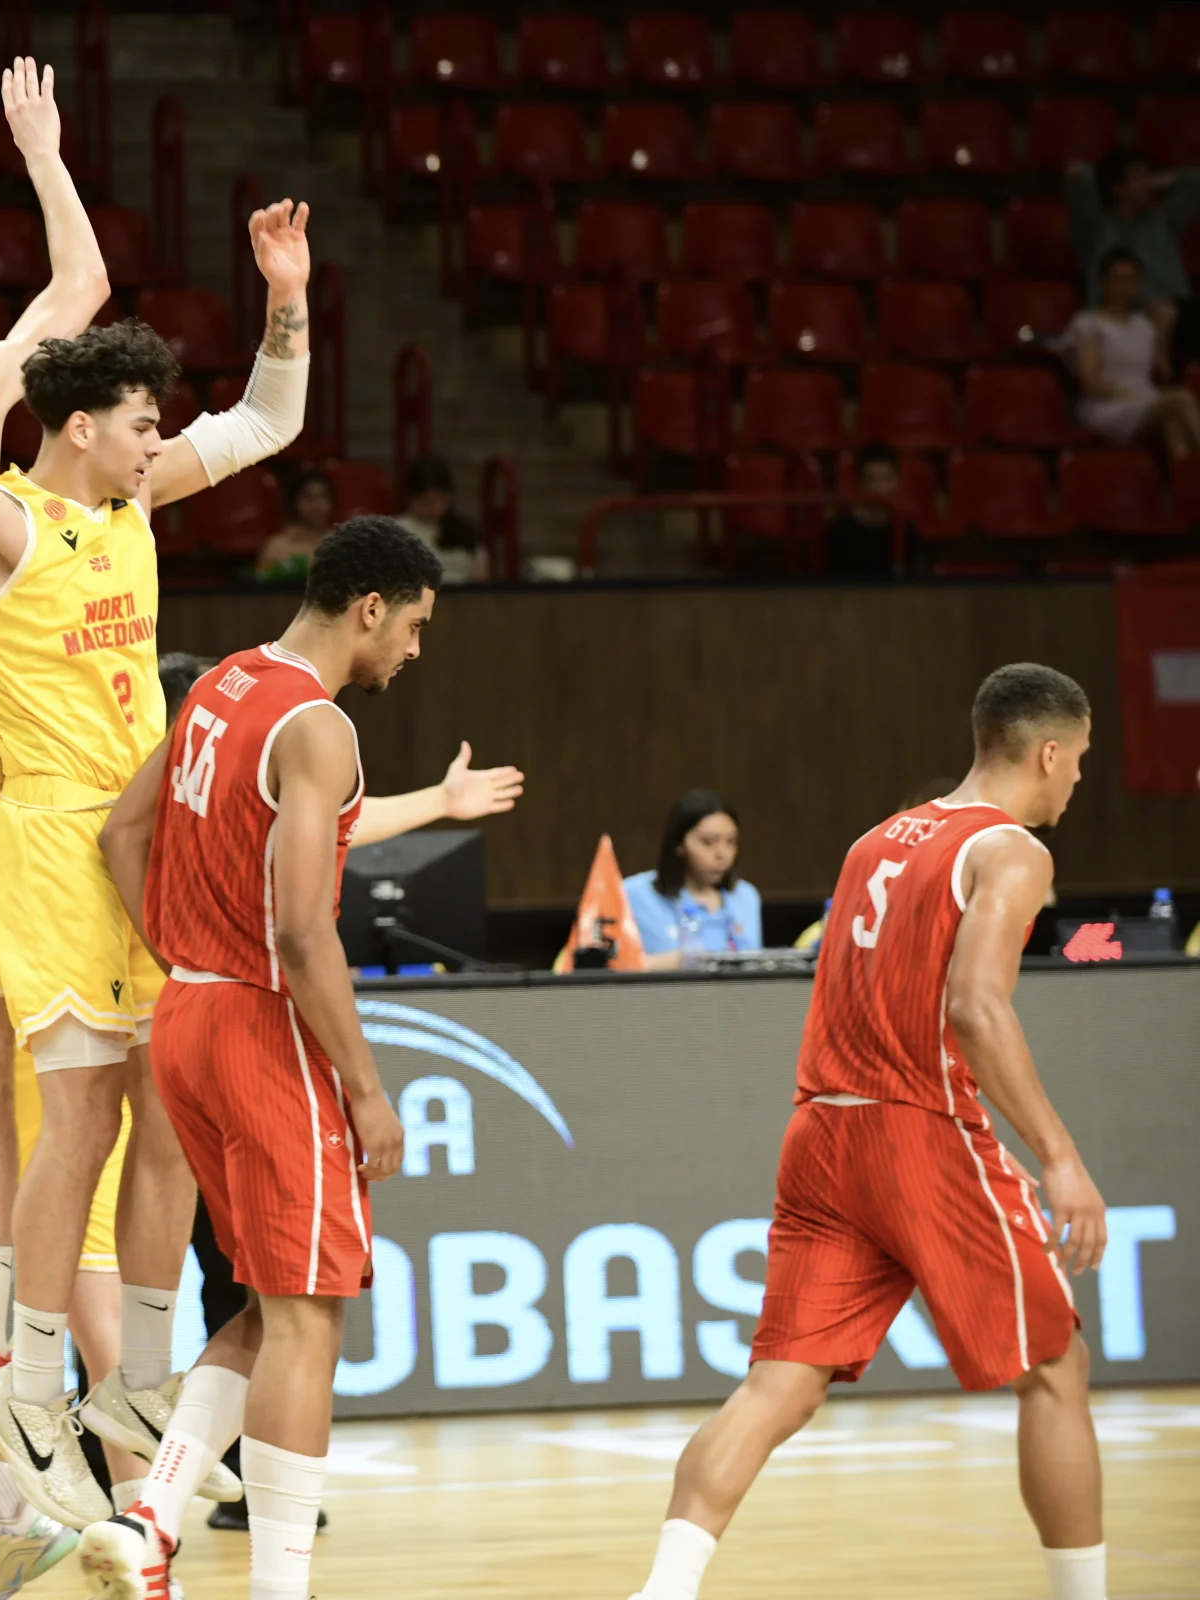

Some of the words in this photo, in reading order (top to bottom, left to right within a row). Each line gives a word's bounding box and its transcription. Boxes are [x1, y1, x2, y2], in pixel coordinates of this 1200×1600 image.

[112, 670, 135, 727] 2
[171, 704, 228, 818] 56
[852, 858, 908, 949] 5
